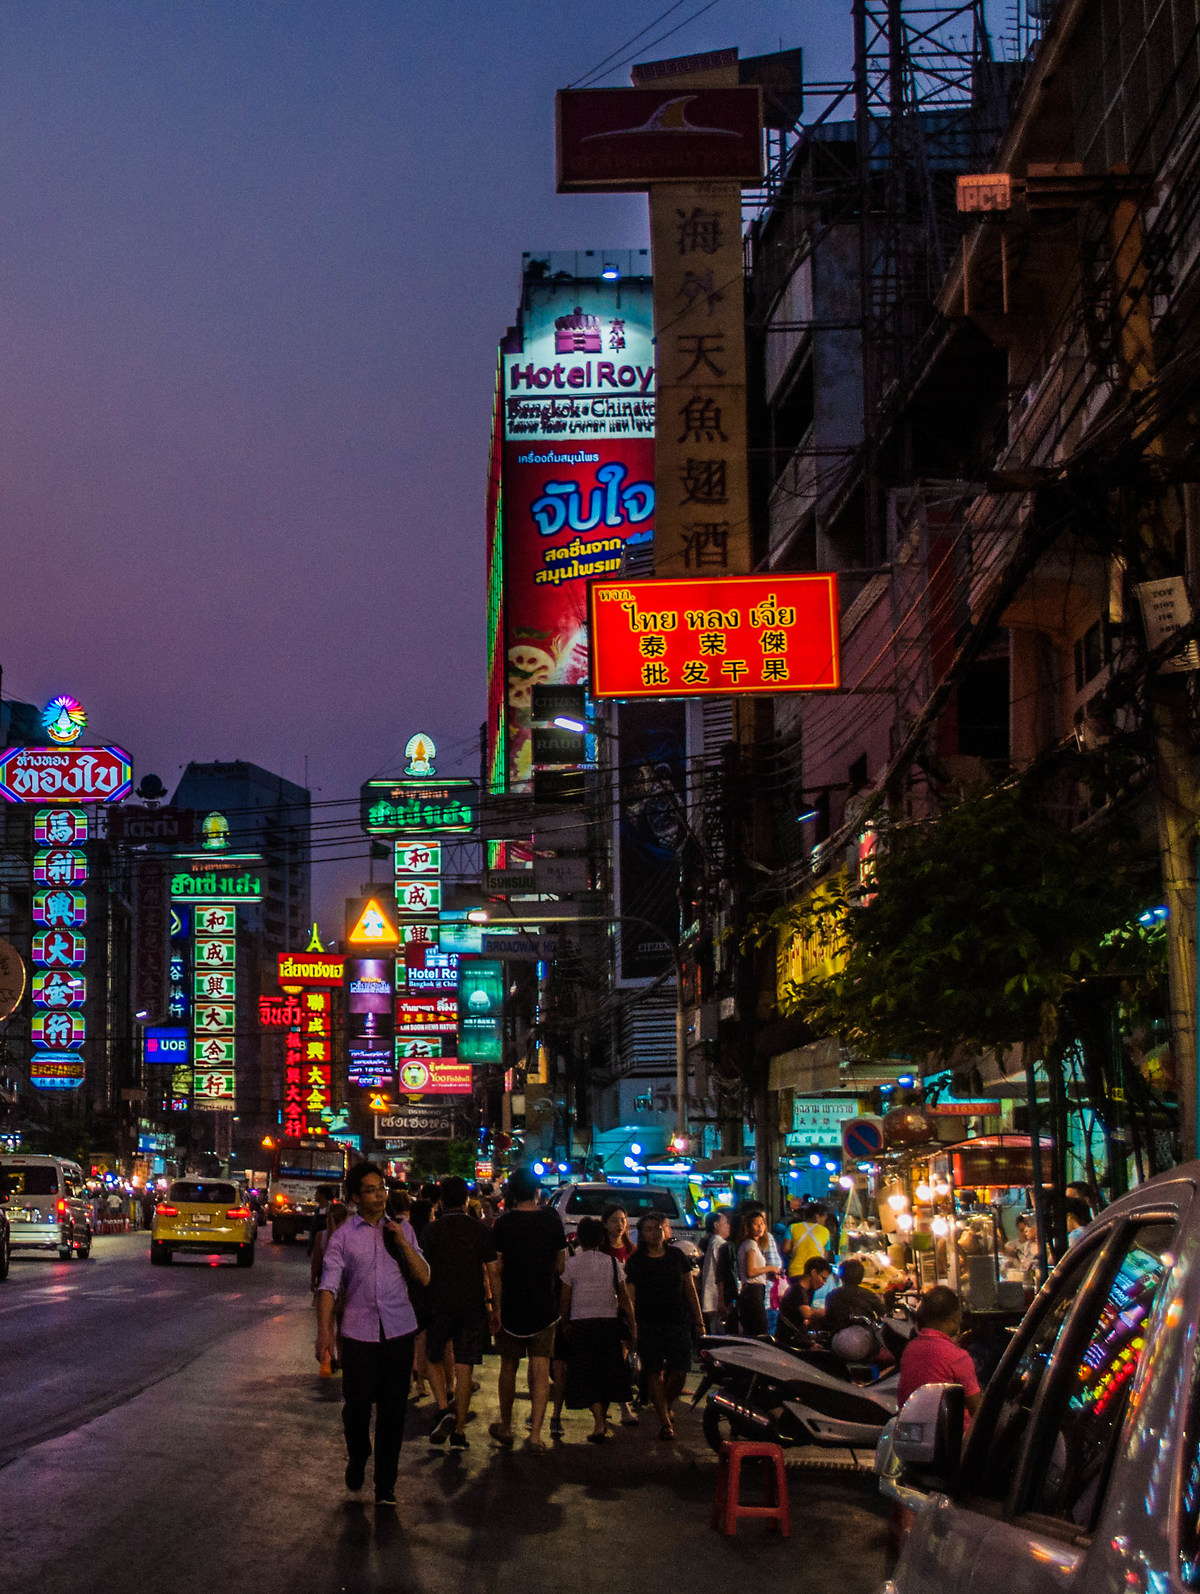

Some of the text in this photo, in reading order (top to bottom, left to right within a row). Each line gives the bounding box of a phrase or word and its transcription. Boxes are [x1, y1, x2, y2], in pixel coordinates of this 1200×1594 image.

[510, 361, 592, 390] Hotel
[507, 398, 580, 420] Bangkok
[518, 449, 600, 465] เครื่องดื่มสมุนไพร
[599, 589, 636, 602] หจก.
[622, 594, 796, 632] ไทย หลง เจี่ย
[642, 659, 788, 686] 批发干果
[17, 751, 69, 766] ห้างทอง
[12, 755, 119, 793] ทองใบ
[408, 967, 439, 979] Hotel
[203, 910, 226, 1096] 和成興大金行
[161, 1040, 186, 1051] UOB
[31, 1064, 82, 1075] EXCHANGE
[306, 993, 326, 1134] 聯成興大金
